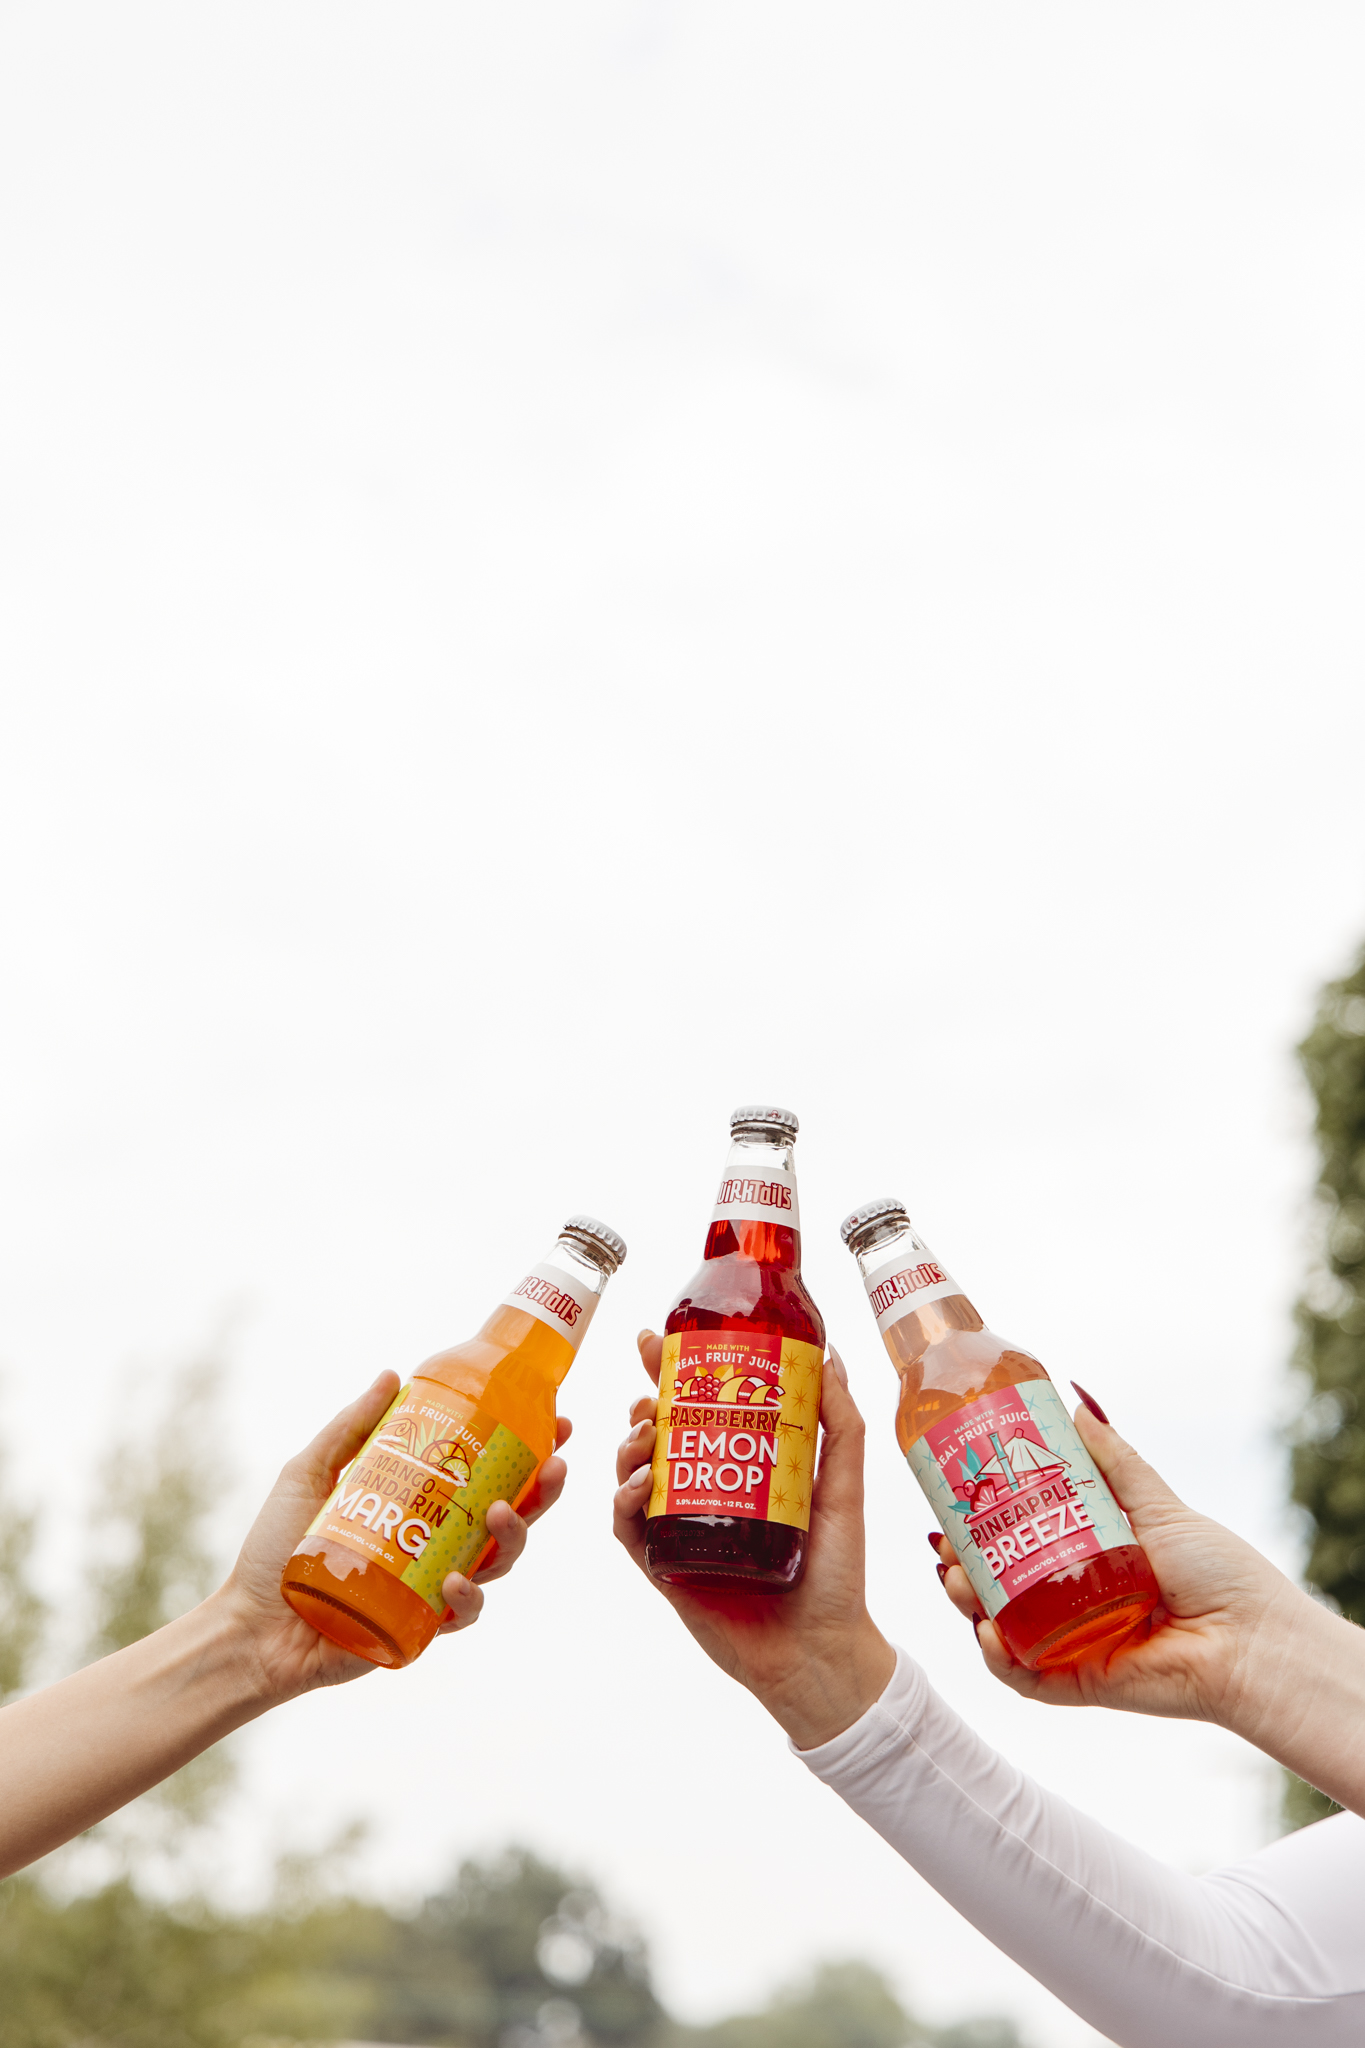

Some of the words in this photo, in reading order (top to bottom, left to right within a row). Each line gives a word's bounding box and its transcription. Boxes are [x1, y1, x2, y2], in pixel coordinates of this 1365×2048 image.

[715, 1179, 792, 1211] UiRkTails
[869, 1263, 947, 1319] UiRkTails
[675, 1354, 702, 1372] REAL
[706, 1352, 745, 1364] FRUIT
[749, 1356, 785, 1377] JUICE
[425, 1399, 445, 1411] MADE
[446, 1407, 464, 1420] WITH
[669, 1406, 782, 1433] RASPBERRY
[953, 1421, 974, 1435] MADE
[975, 1409, 994, 1421] WITH
[392, 1404, 416, 1416] REAL
[419, 1406, 455, 1427] FRUIT
[455, 1425, 488, 1458] JUICE
[666, 1430, 780, 1467] LEMON
[934, 1444, 958, 1472] REAL
[958, 1419, 994, 1446] FRUIT
[999, 1410, 1037, 1426] JUICE
[372, 1454, 436, 1494] MANGO
[673, 1461, 764, 1495] DROP
[346, 1464, 450, 1528] MANDARIN
[676, 1498, 691, 1506] 5.9%
[692, 1499, 723, 1507] ALC/VOL
[735, 1501, 744, 1509] FL
[745, 1502, 756, 1510] OZ.
[969, 1477, 1078, 1549] PINEAPPLE
[325, 1484, 432, 1562] MARG
[339, 1528, 366, 1545] ALC/VOL
[368, 1542, 375, 1551] 12
[376, 1547, 383, 1556] FL
[980, 1498, 1095, 1581] BREEZE
[1012, 1574, 1027, 1586] 5.9%
[1027, 1556, 1057, 1577] ALC/VOL
[1060, 1550, 1067, 1559] 12
[1067, 1546, 1076, 1556] FL
